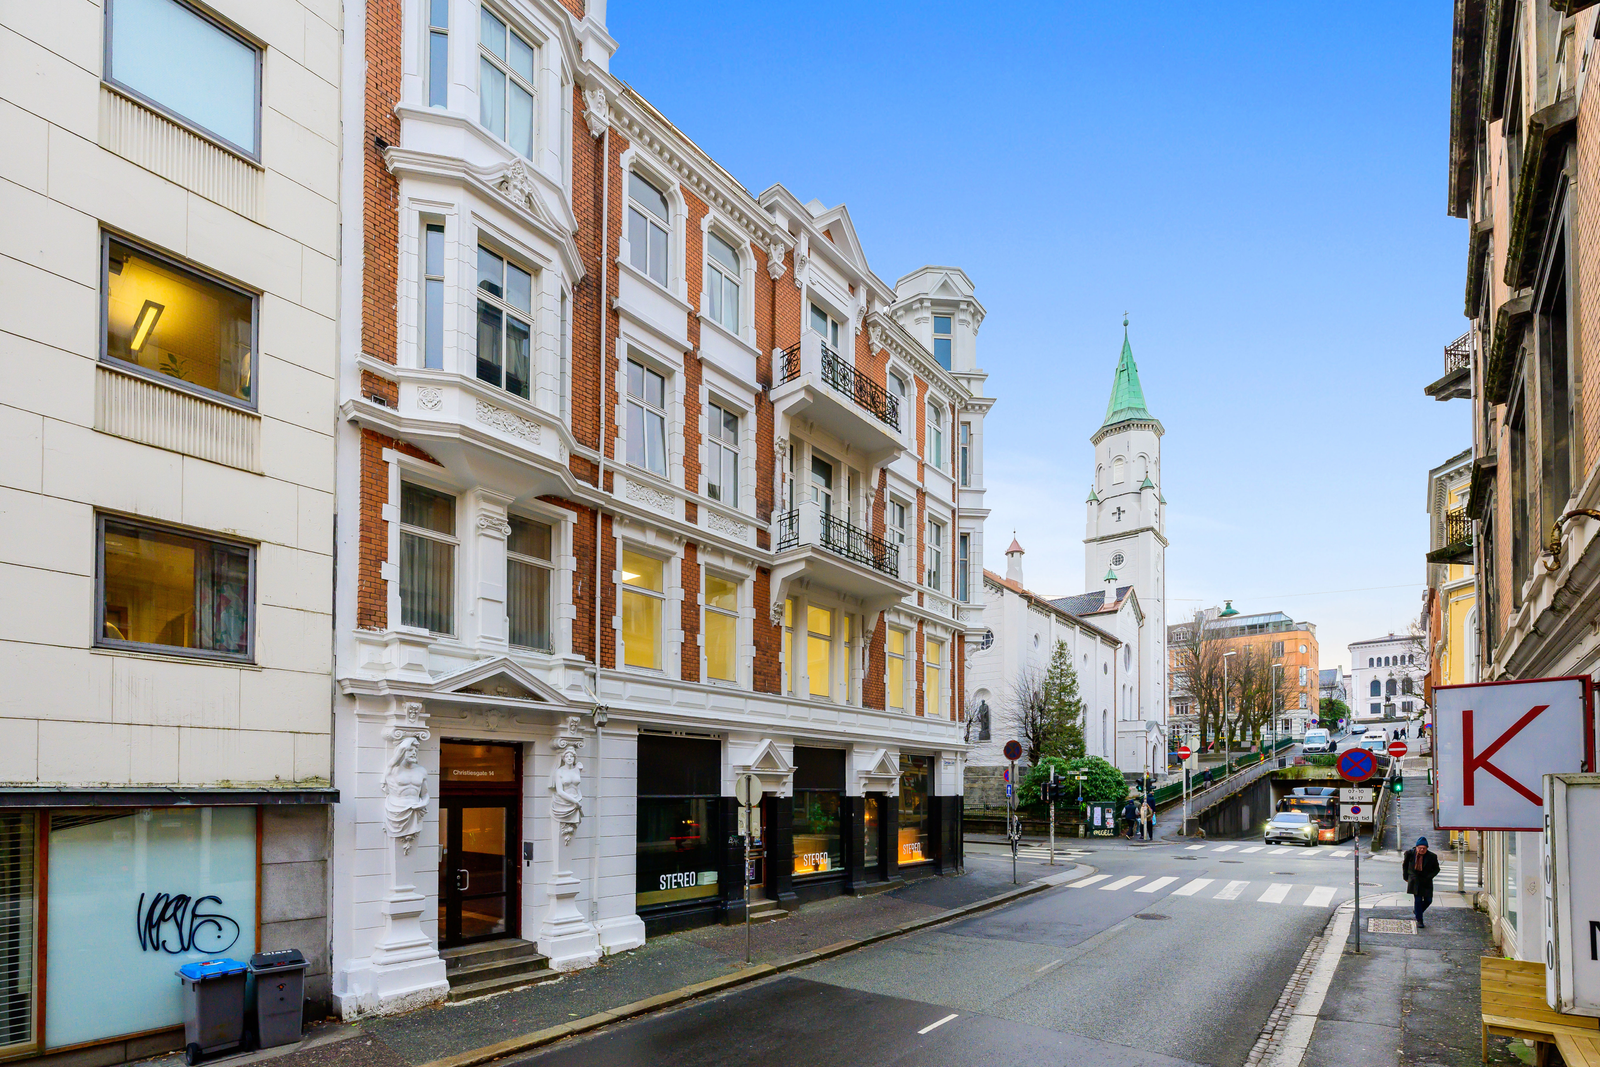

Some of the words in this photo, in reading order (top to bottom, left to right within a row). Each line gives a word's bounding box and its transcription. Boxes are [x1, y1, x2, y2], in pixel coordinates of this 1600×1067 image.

[1462, 705, 1550, 806] K
[903, 843, 921, 854] STEREO
[803, 852, 828, 866] STEREO
[660, 871, 696, 890] STEREO
